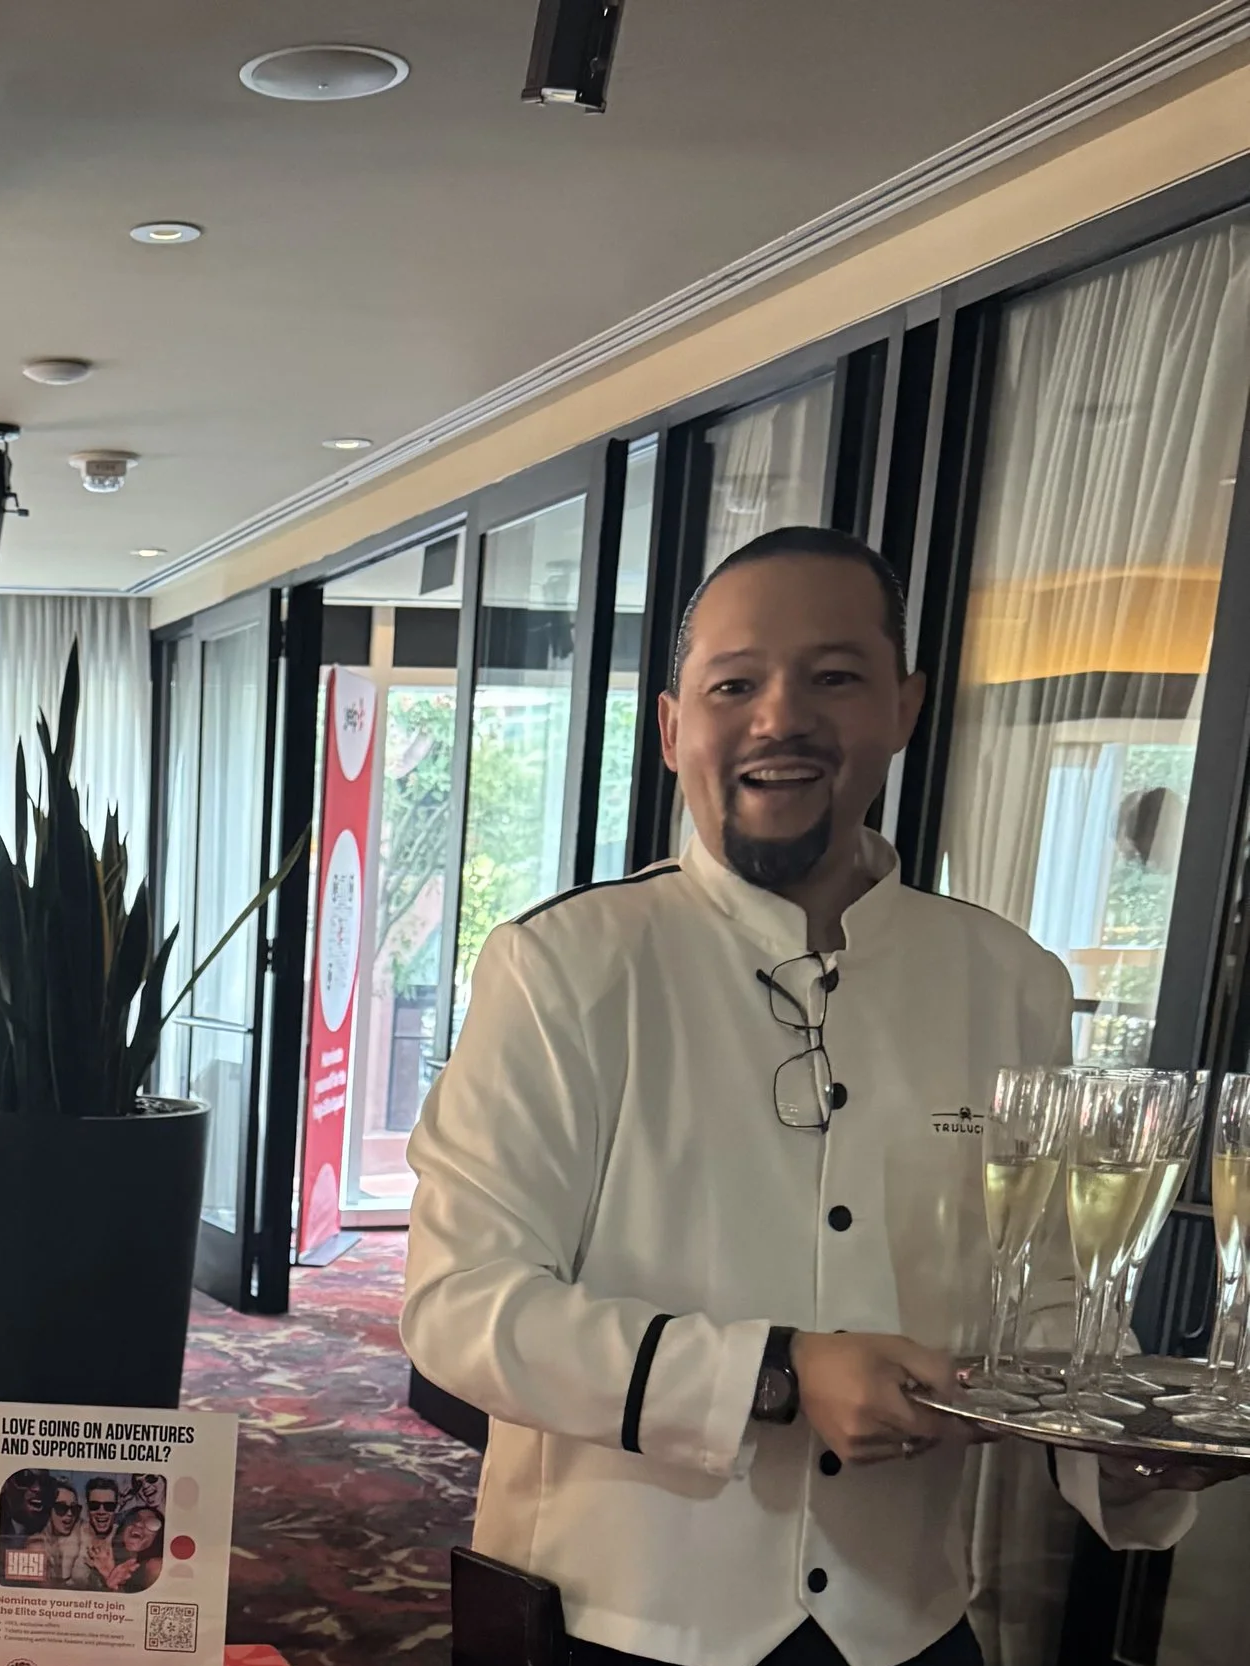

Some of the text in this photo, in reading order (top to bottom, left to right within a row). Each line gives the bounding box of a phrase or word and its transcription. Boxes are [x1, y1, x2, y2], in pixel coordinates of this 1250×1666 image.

[2, 1417, 195, 1443] LOVE GOING ON ADVENTURES
[1, 1438, 171, 1462] AND SUPPORTING LOCAL?
[8, 1551, 44, 1576] YES!
[15, 1608, 36, 1616] Elite
[39, 1609, 71, 1619] Squad
[74, 1611, 94, 1619] and
[50, 1599, 91, 1609] yourself
[106, 1601, 125, 1611] join
